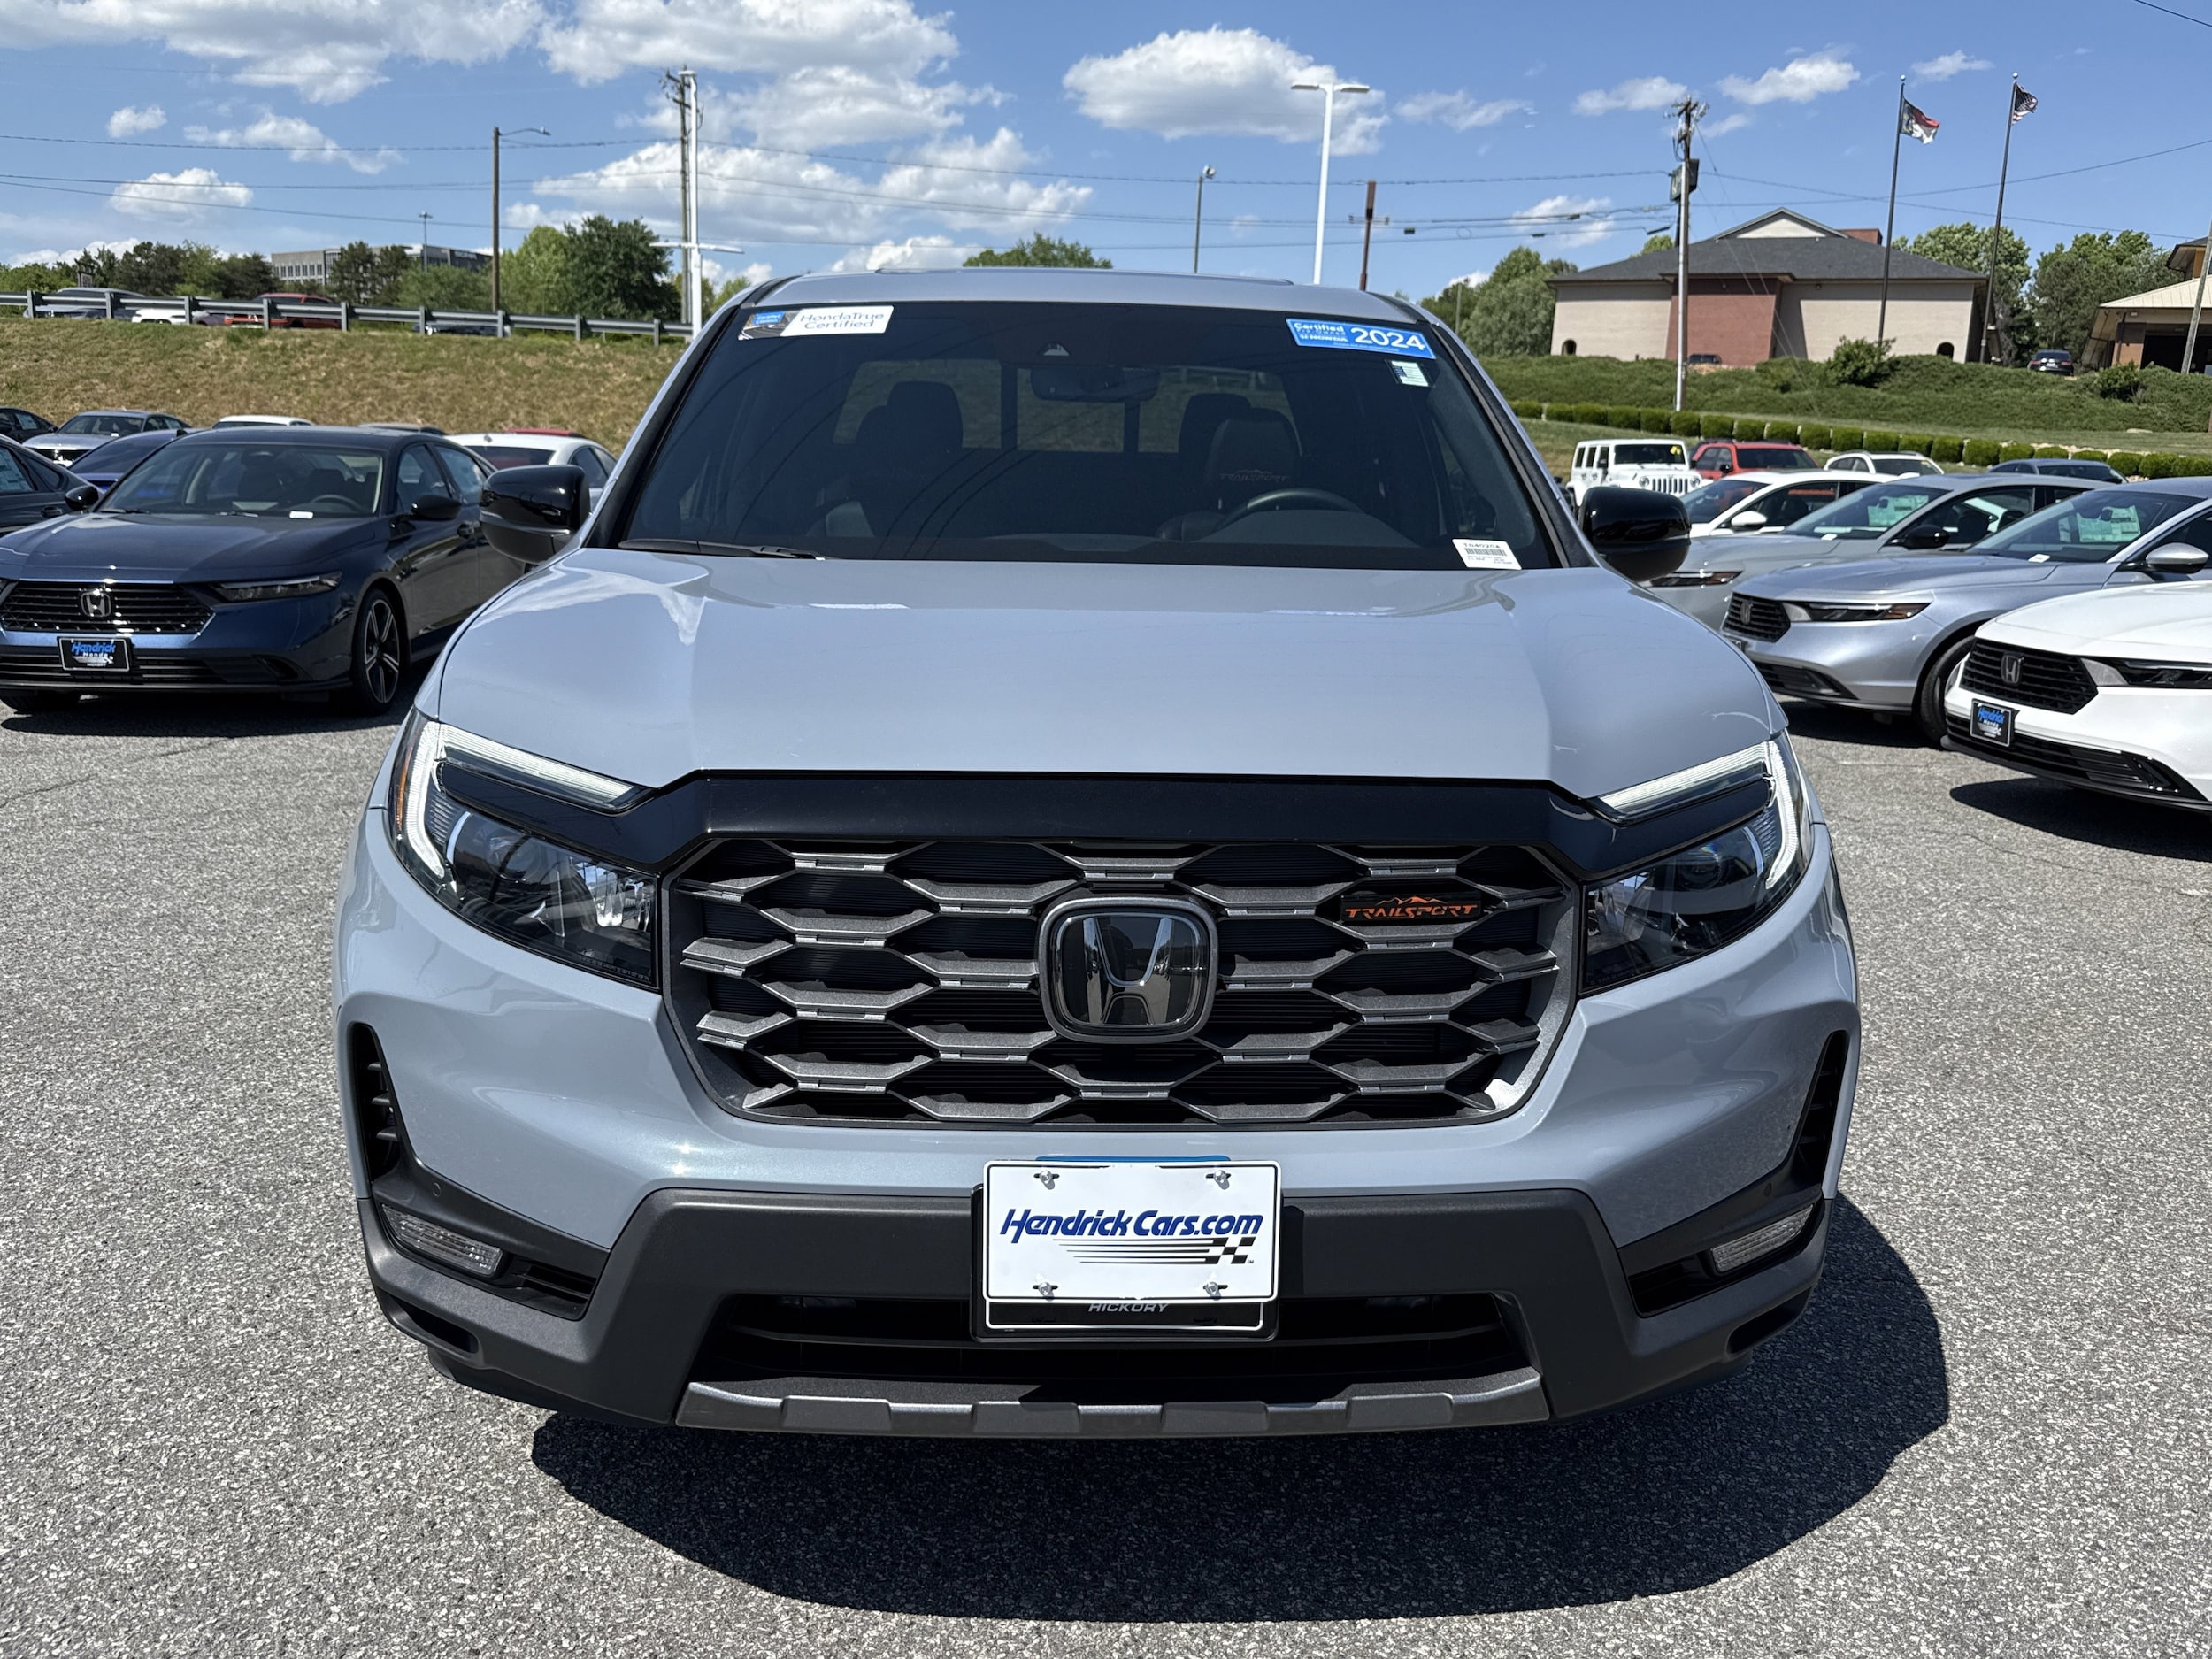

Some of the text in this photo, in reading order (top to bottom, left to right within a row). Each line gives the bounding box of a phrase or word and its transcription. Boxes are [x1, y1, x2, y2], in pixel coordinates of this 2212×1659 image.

[800, 311, 885, 322] HondaTrue
[804, 319, 874, 329] Certified
[1294, 322, 1345, 333] Certified
[1350, 327, 1425, 351] 2024
[1345, 904, 1478, 920] TRAILSPORT
[1087, 1302, 1169, 1312] HICKORY
